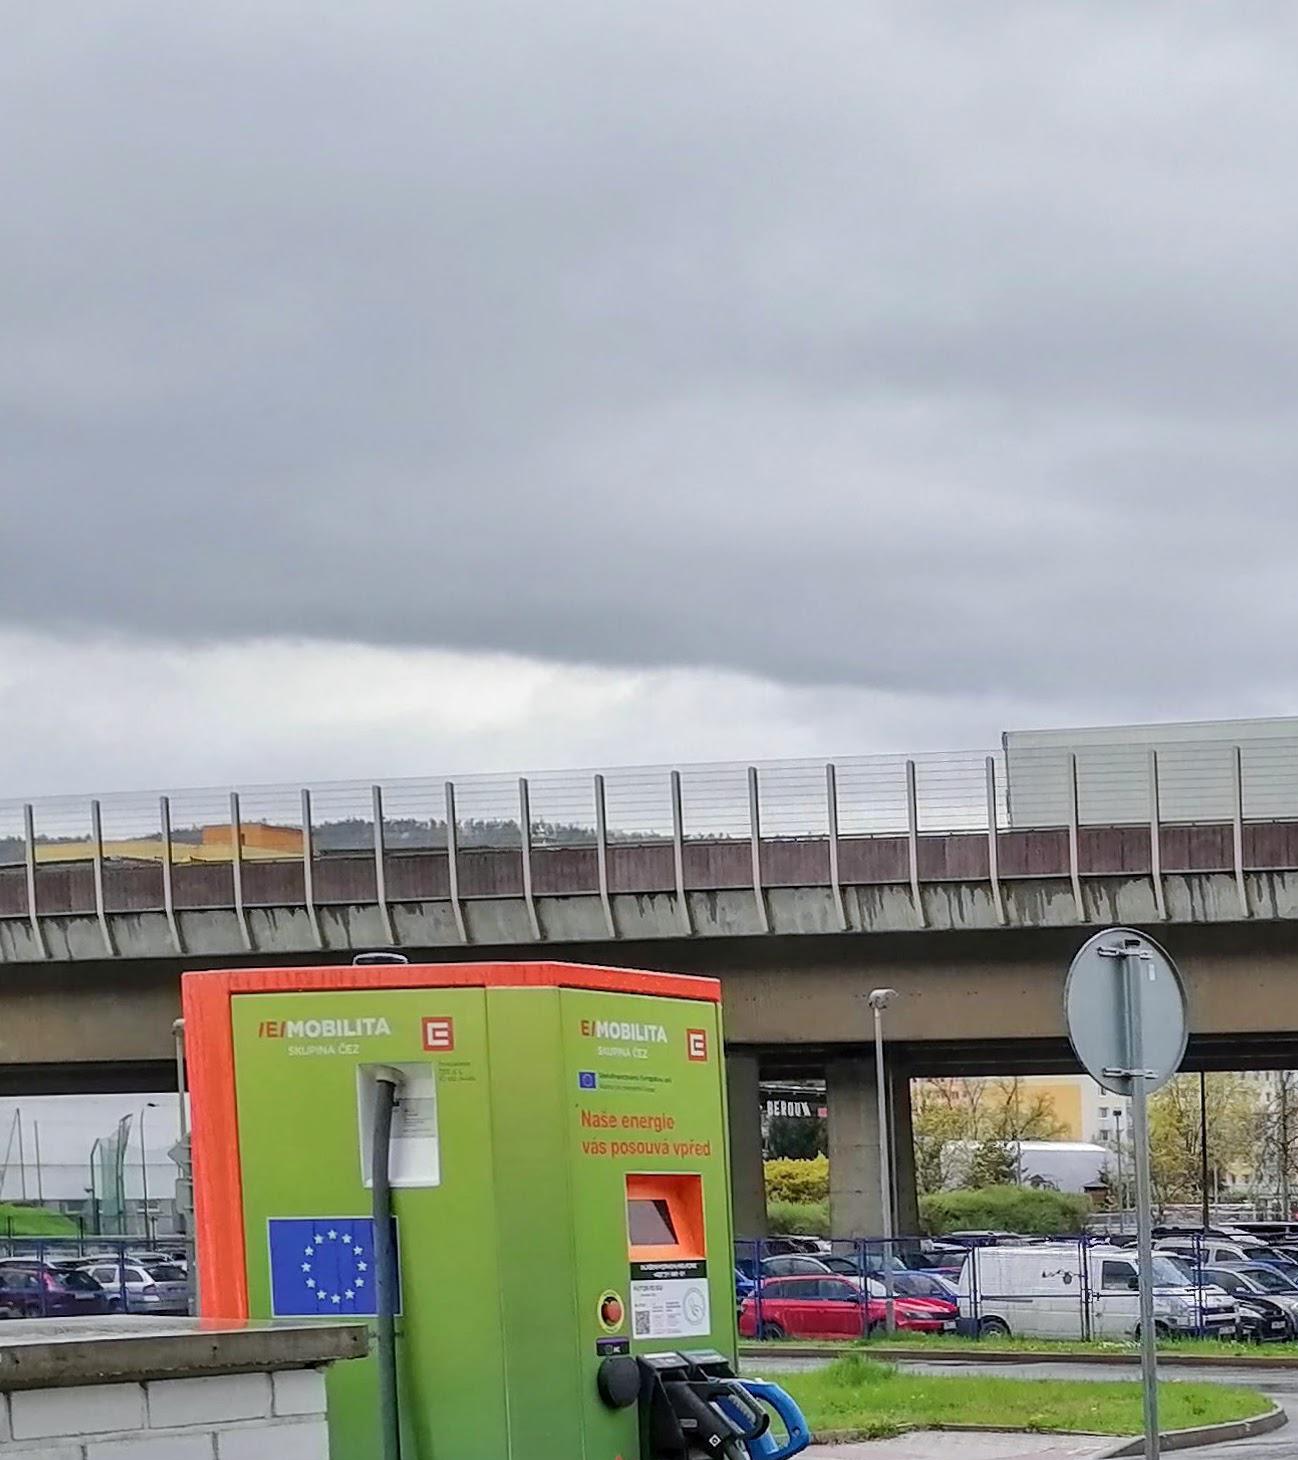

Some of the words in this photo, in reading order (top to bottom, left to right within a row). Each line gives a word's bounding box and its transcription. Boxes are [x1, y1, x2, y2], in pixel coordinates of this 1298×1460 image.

[581, 1109, 617, 1128] Naše
[621, 1112, 675, 1133] energie
[582, 1136, 608, 1154] vás
[611, 1137, 670, 1158] posouvá
[673, 1138, 712, 1158] vpřed
